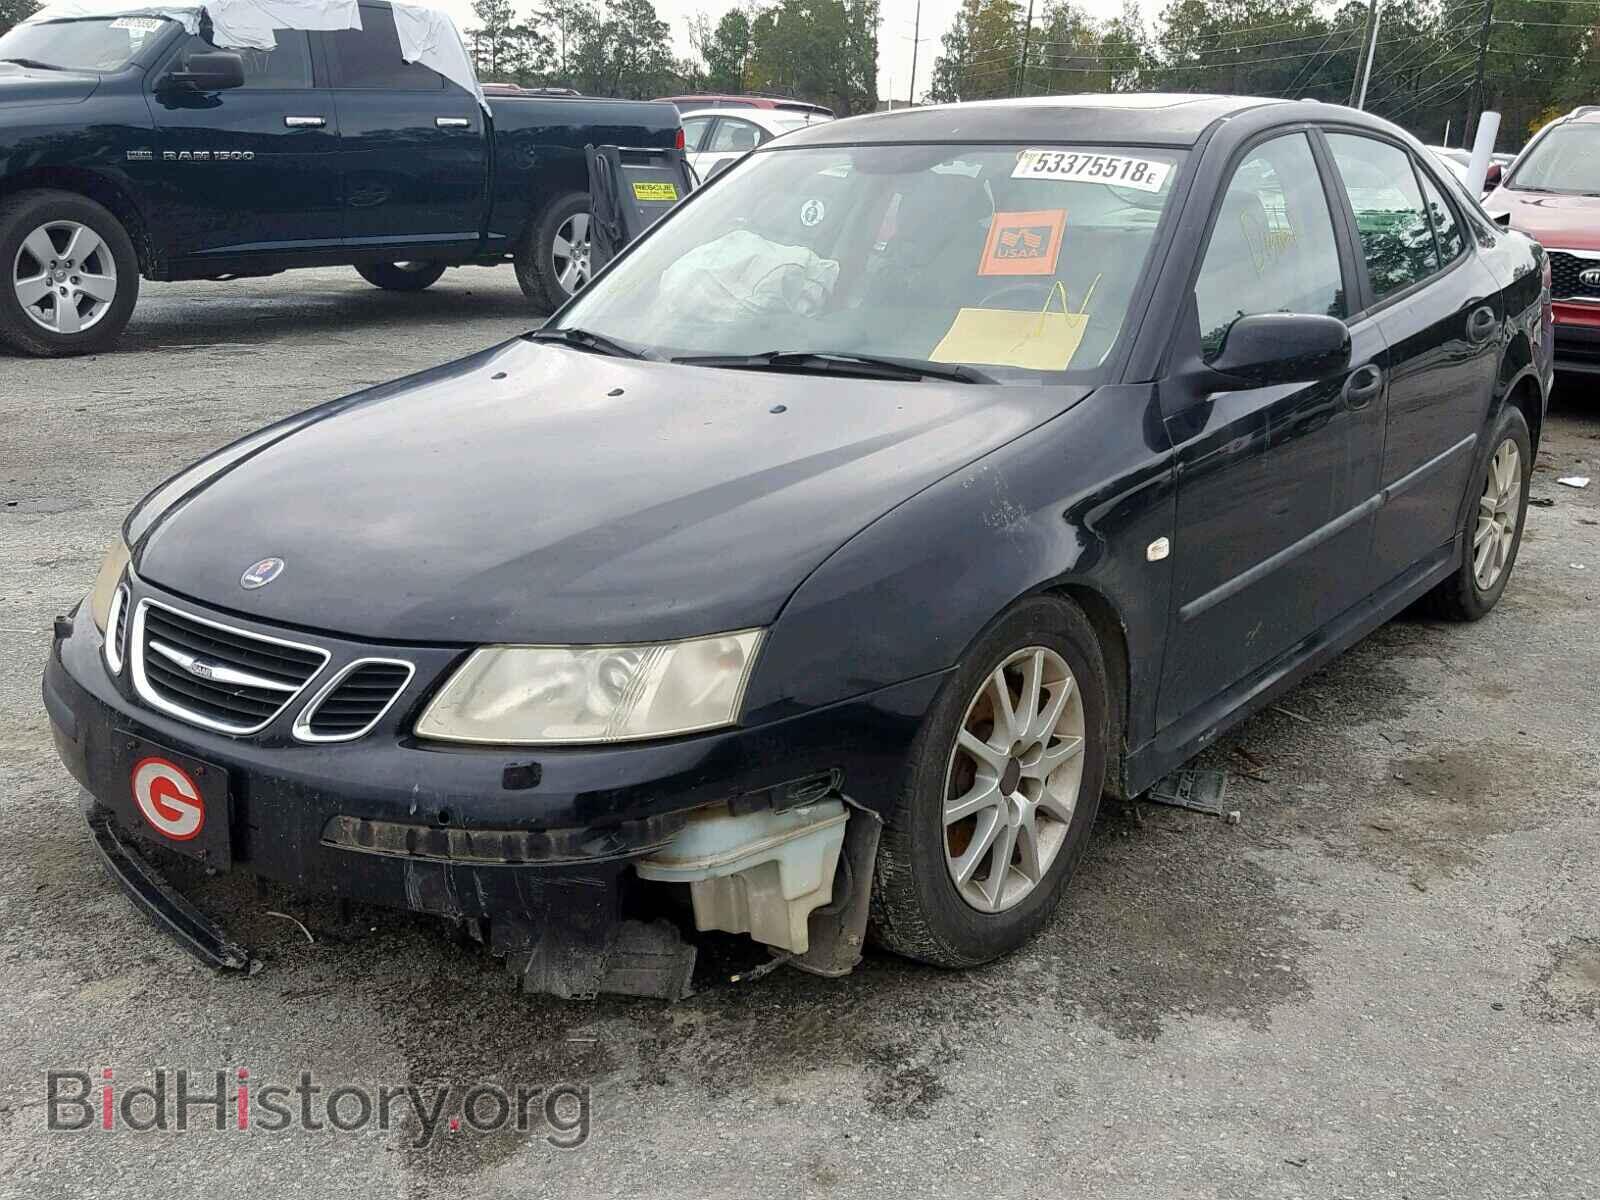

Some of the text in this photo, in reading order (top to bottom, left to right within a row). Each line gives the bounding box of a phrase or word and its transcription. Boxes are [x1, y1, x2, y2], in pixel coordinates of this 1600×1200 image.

[162, 151, 255, 160] RAM 1500
[998, 246, 1040, 258] USAA
[134, 762, 201, 836] G
